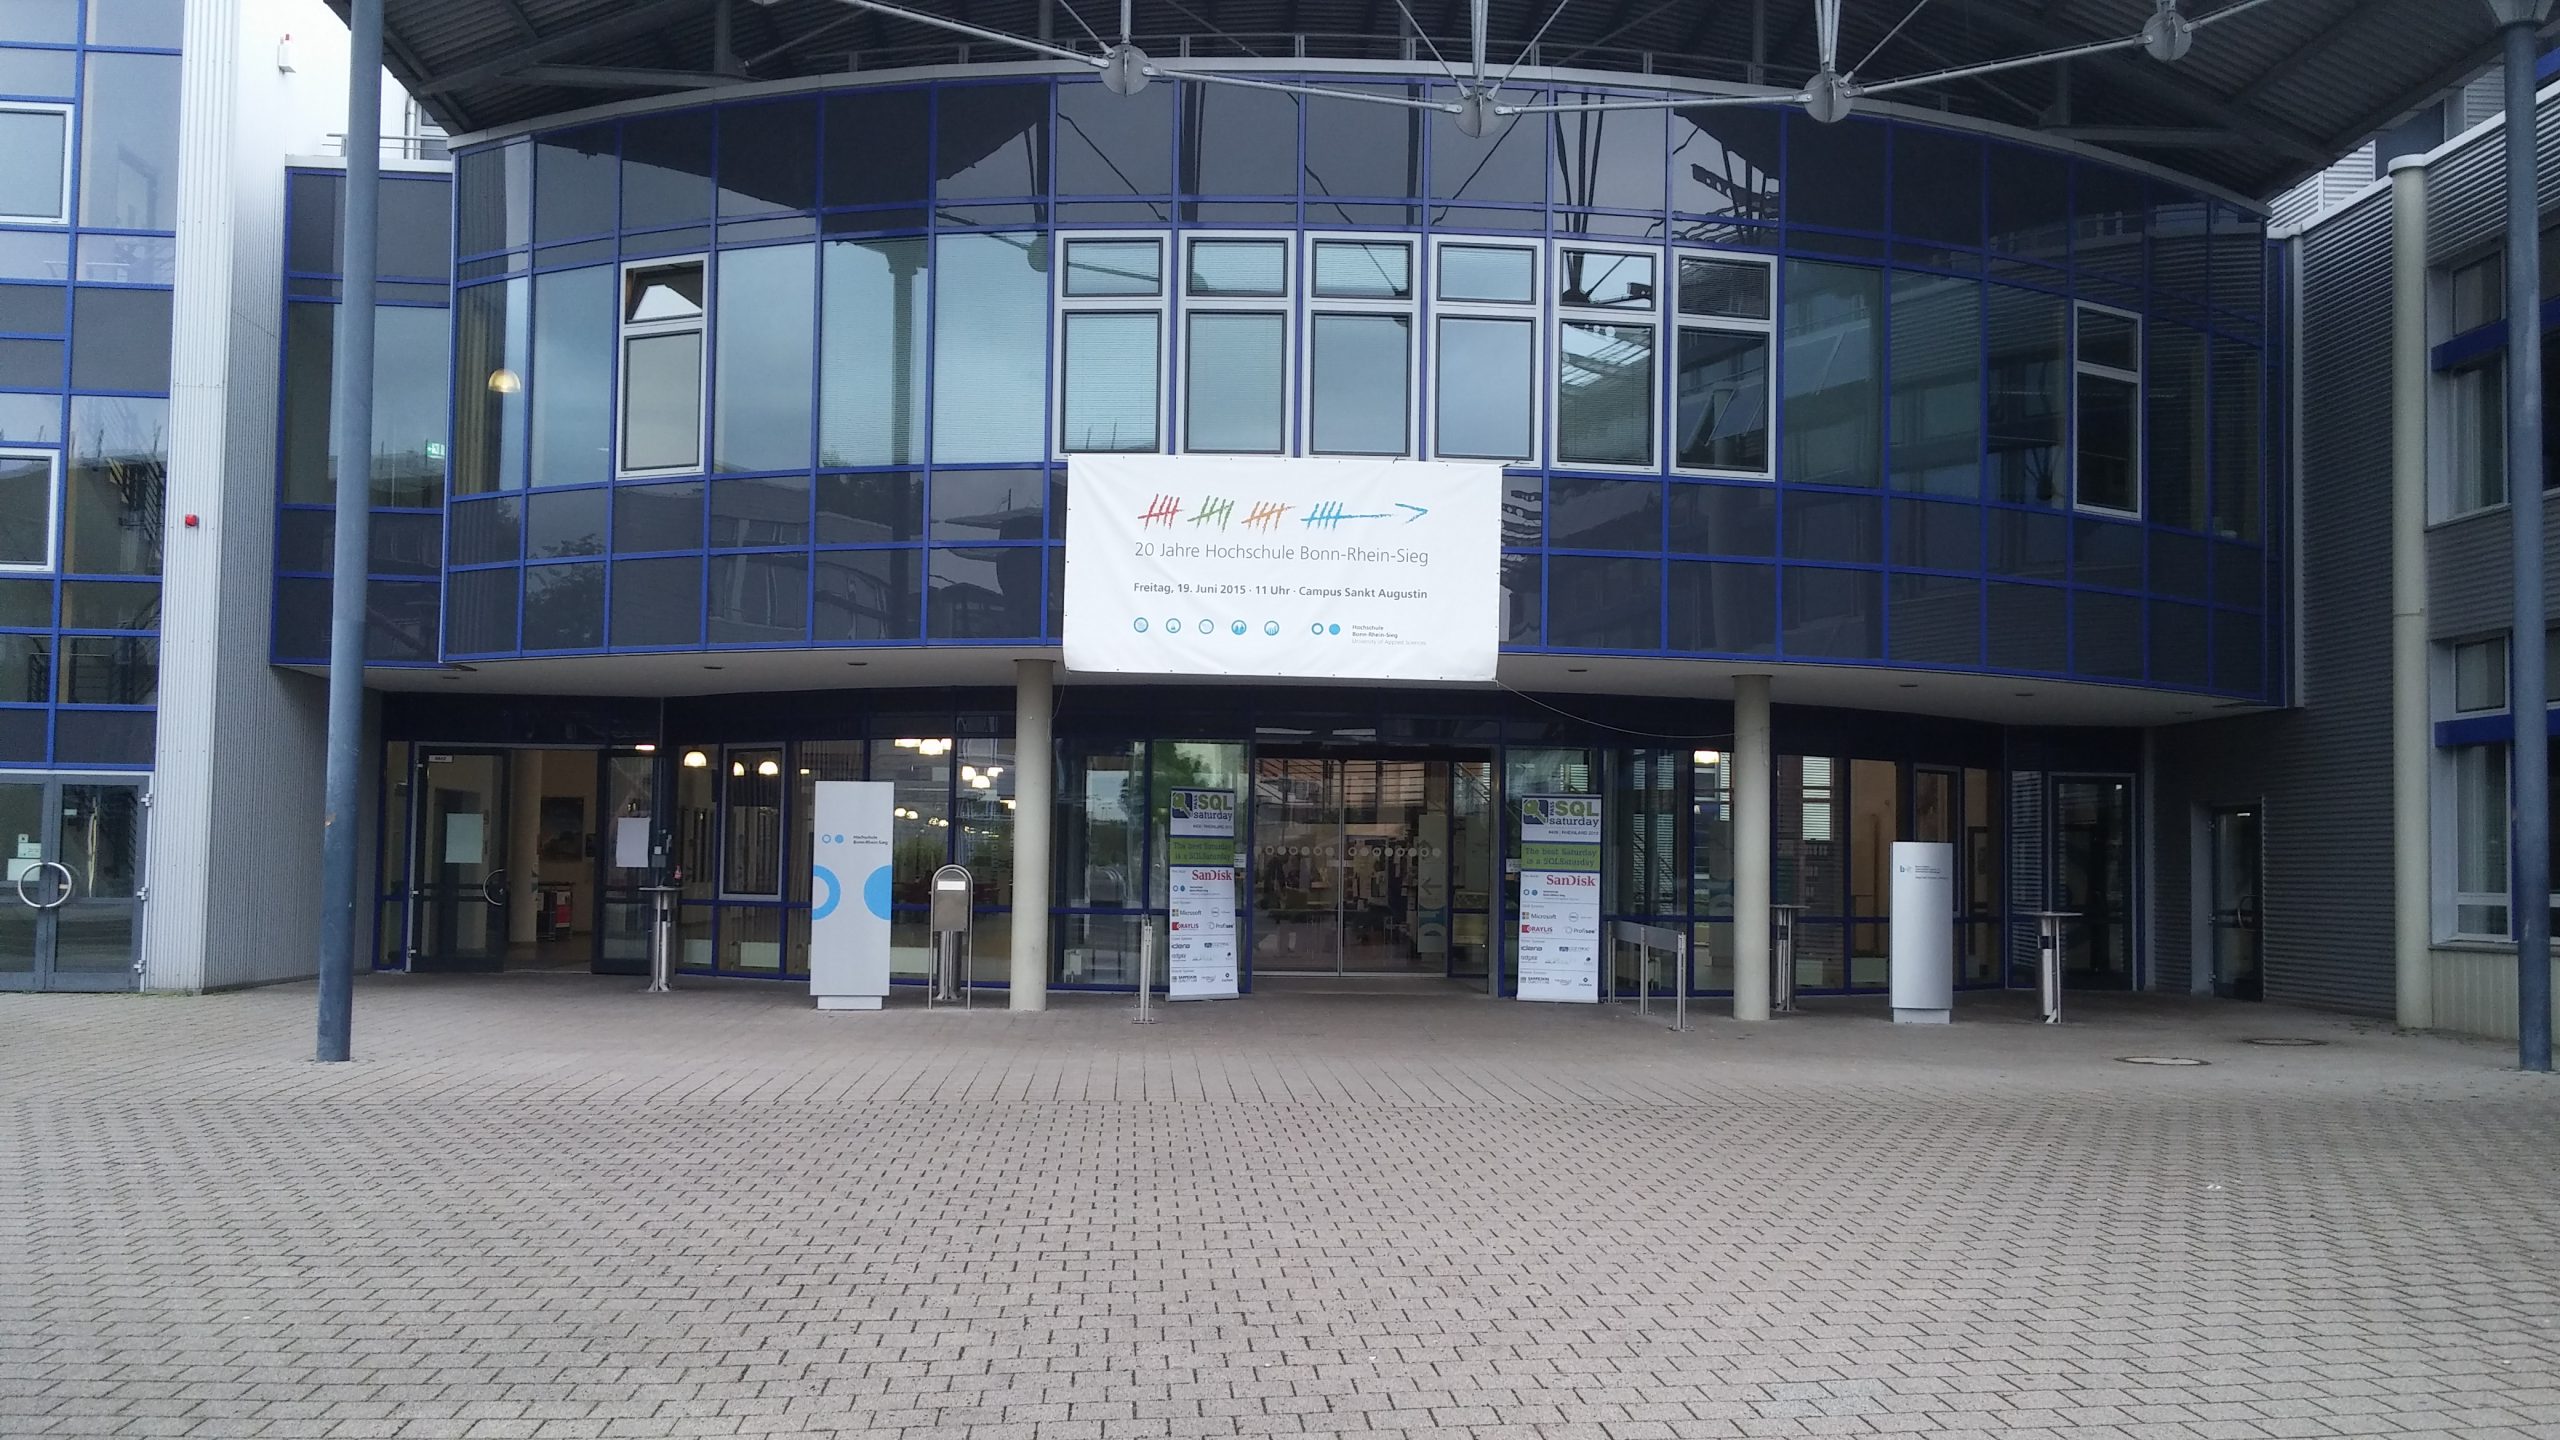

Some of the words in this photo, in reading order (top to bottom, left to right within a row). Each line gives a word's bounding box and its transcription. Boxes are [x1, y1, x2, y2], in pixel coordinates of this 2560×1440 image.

[1134, 542, 1155, 557] 20
[1160, 542, 1200, 558] Jahre
[1205, 544, 1295, 560] Hochschule
[1300, 546, 1429, 567] Bonn-Rhein-Sieg
[1134, 583, 1174, 595] Freitag,
[1178, 584, 1193, 593] 19.
[1196, 584, 1218, 594] Juni
[1220, 585, 1246, 594] 2015
[1255, 586, 1267, 595] 11
[1270, 586, 1291, 595] Uhr
[1299, 586, 1342, 598] Campus
[1344, 588, 1376, 598] Sankt
[1378, 588, 1428, 600] Augustin
[1198, 794, 1233, 812] SQL
[1555, 800, 1600, 817] SQL
[1193, 811, 1233, 822] saturday
[1549, 817, 1600, 827] saturday
[1525, 847, 1540, 855] The
[1561, 847, 1597, 857] Saturday
[1191, 869, 1233, 881] SanDisk
[1546, 874, 1596, 887] SanDisk
[1530, 912, 1557, 920] Microsoft
